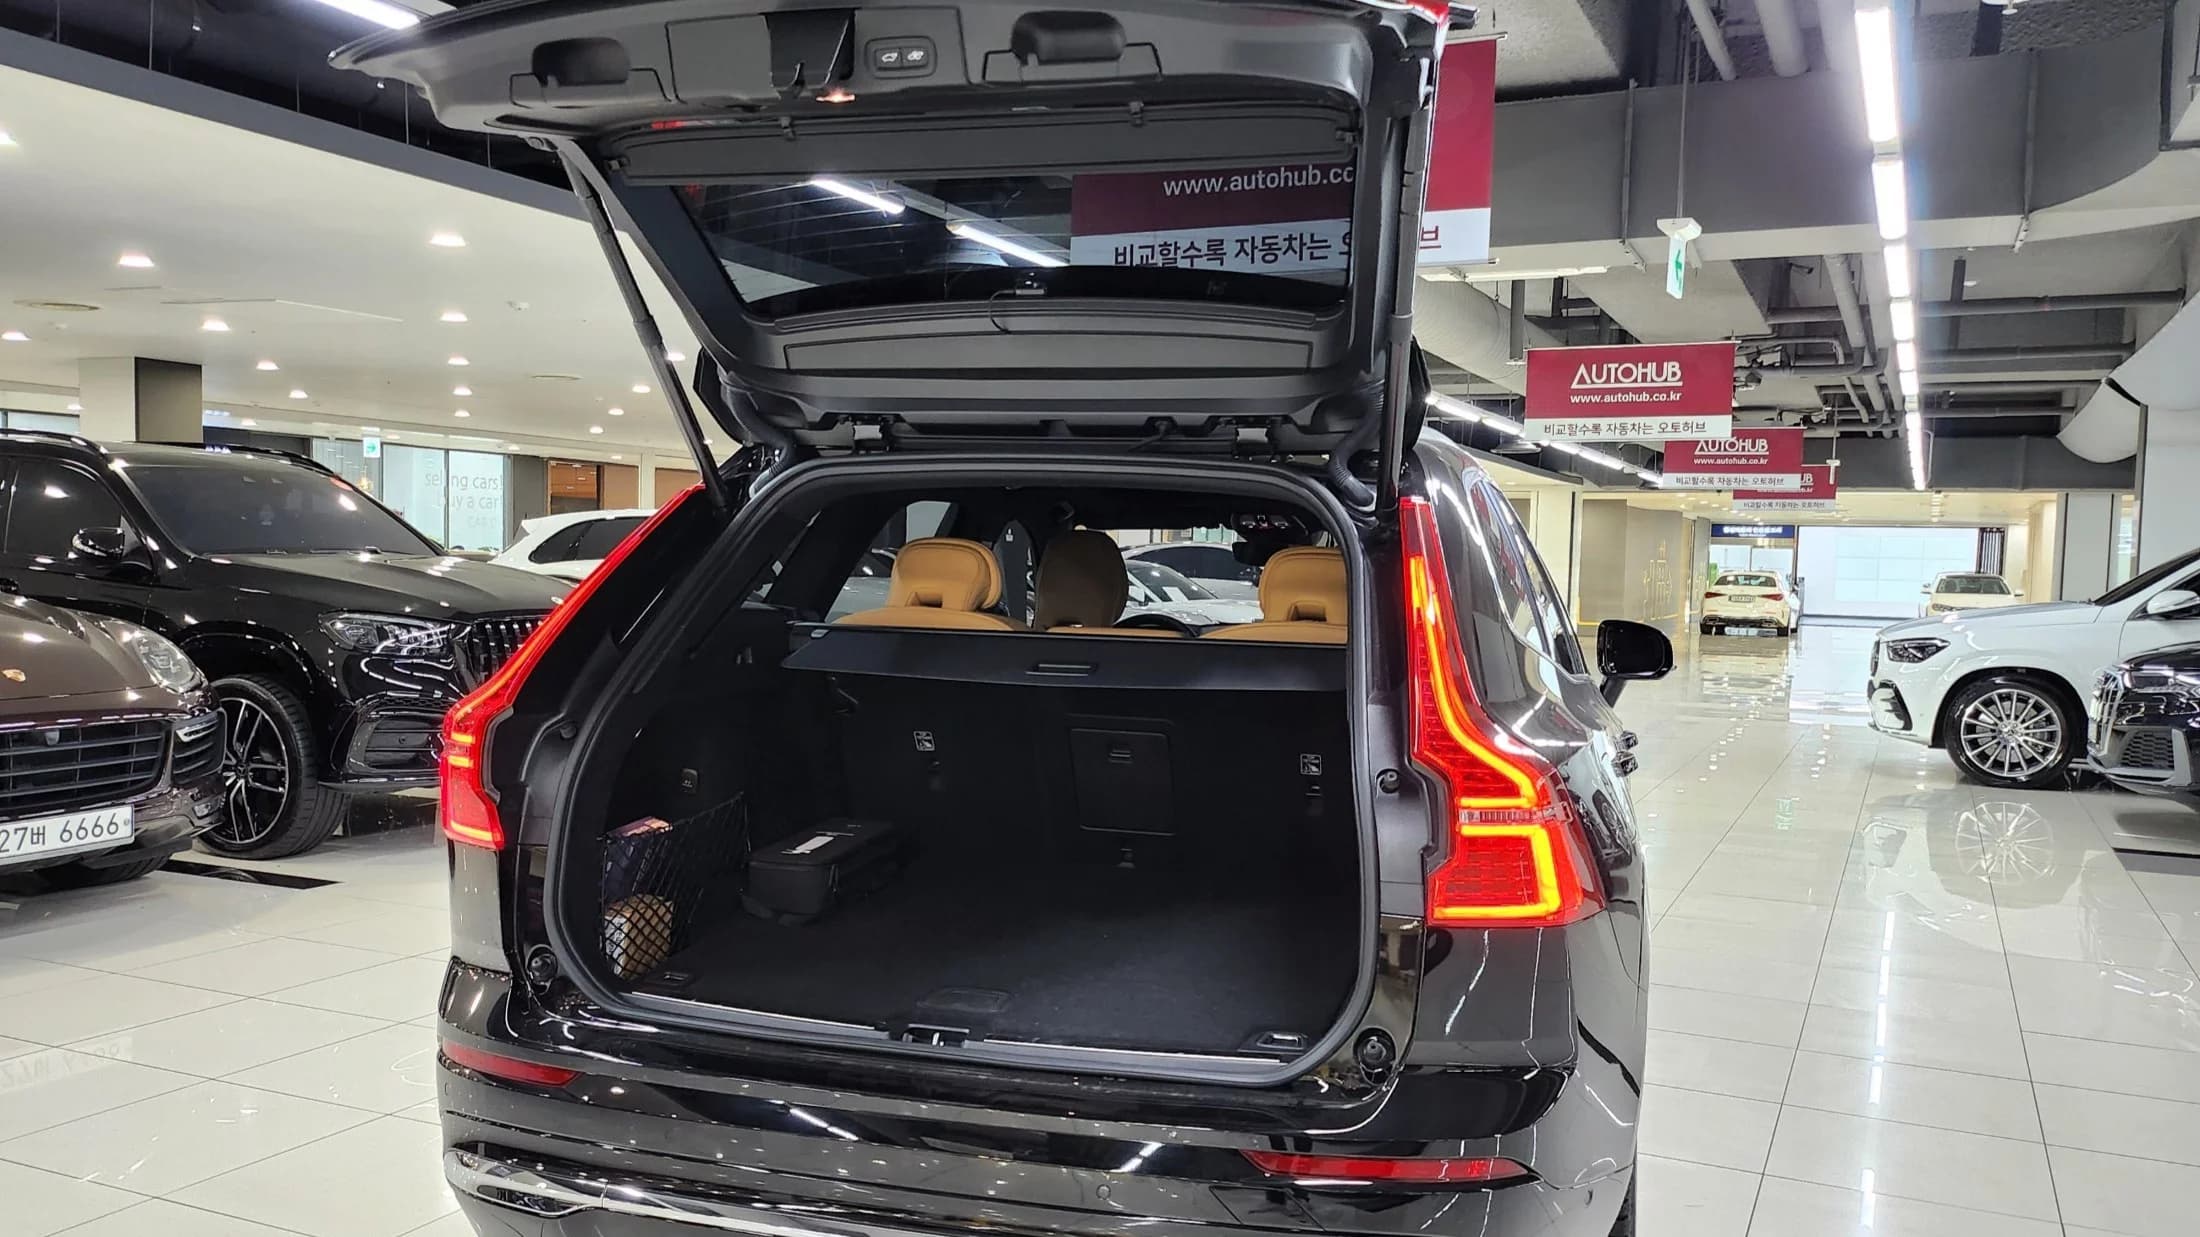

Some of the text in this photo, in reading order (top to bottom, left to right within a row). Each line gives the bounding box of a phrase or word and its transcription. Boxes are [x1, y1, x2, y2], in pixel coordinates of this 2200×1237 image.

[1114, 239, 1227, 268] 비교할수록
[1235, 232, 1332, 265] 자동차는
[1571, 361, 1683, 389] AUTOHUB
[1570, 390, 1683, 404] www.autohub.co.kr
[1544, 420, 1708, 436] 비교할수록 자동차는 오토허브
[1694, 438, 1769, 455] AUTOHUB
[1693, 456, 1769, 466] www.autohub.co.kr
[1675, 476, 1785, 487] 비교할수록 자동차는 오토허브
[0, 812, 119, 852] 27버 6666
